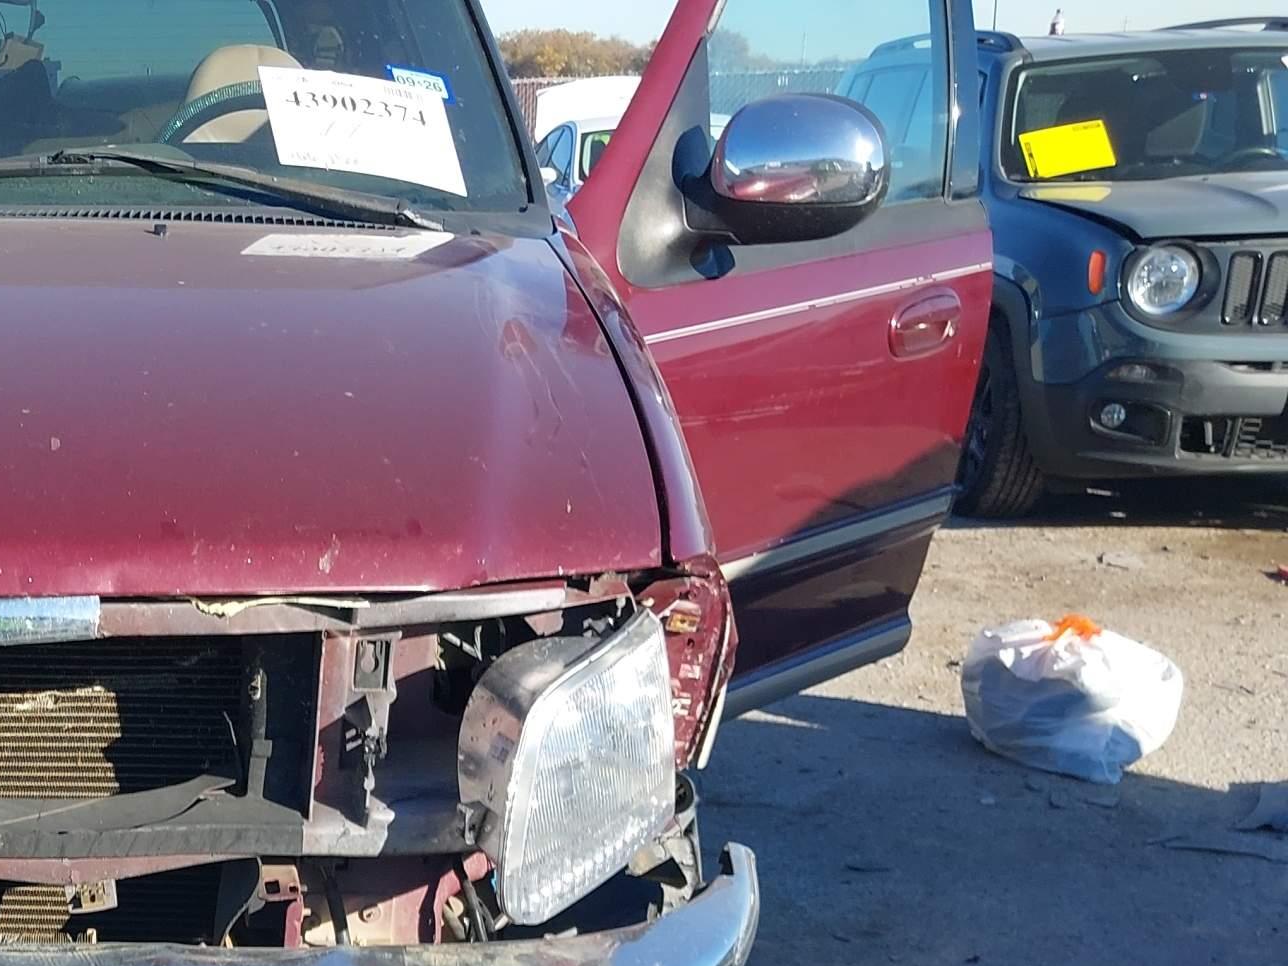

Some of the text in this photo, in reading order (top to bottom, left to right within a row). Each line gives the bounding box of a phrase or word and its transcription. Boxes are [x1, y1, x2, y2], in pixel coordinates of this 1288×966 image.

[396, 74, 443, 93] 09 26
[284, 90, 427, 127] 43902374
